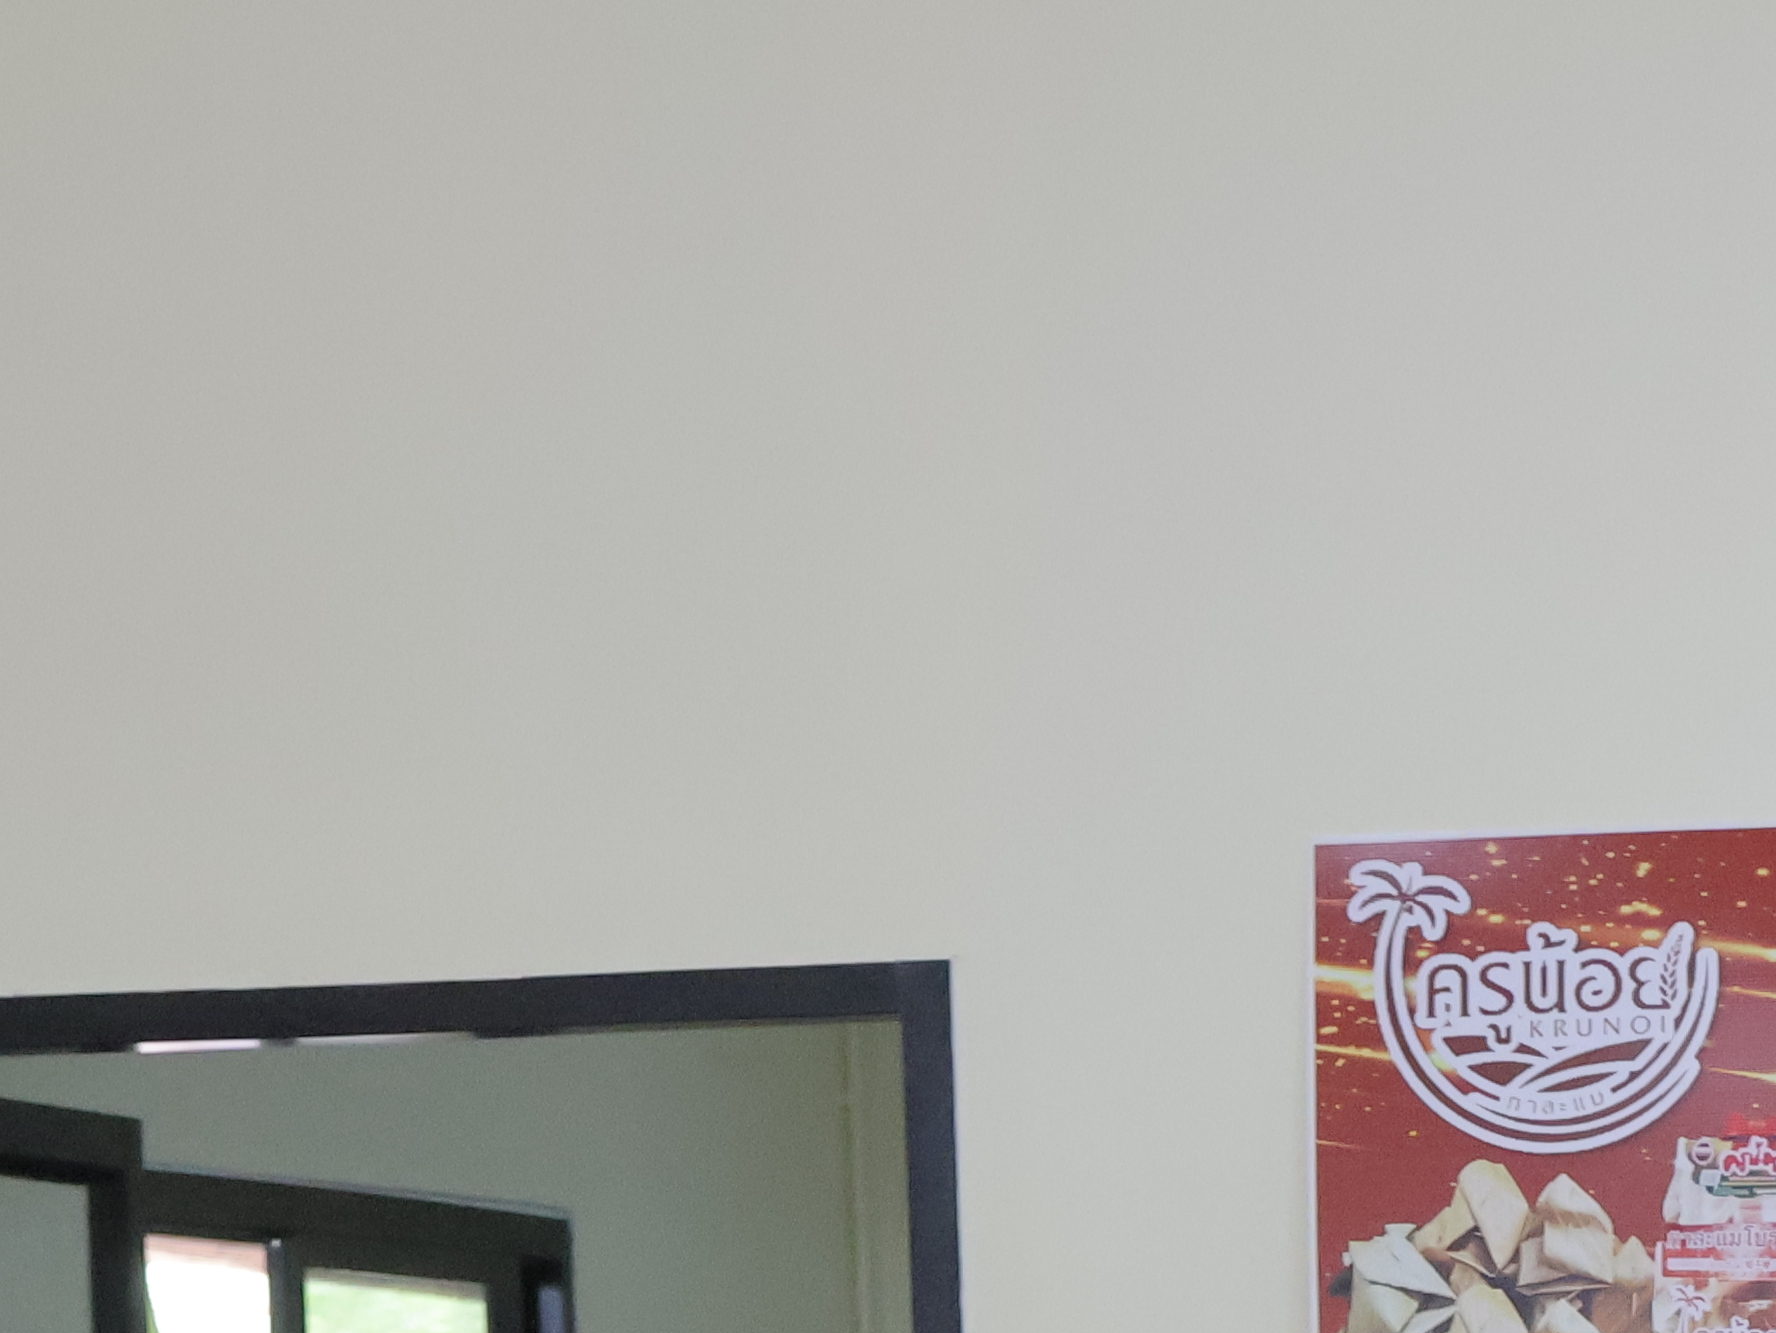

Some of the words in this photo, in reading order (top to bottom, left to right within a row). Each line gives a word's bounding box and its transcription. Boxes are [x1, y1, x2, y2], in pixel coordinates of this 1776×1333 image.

[1427, 931, 1684, 1043] ครูน้อย
[1529, 1013, 1666, 1039] KRUNOI
